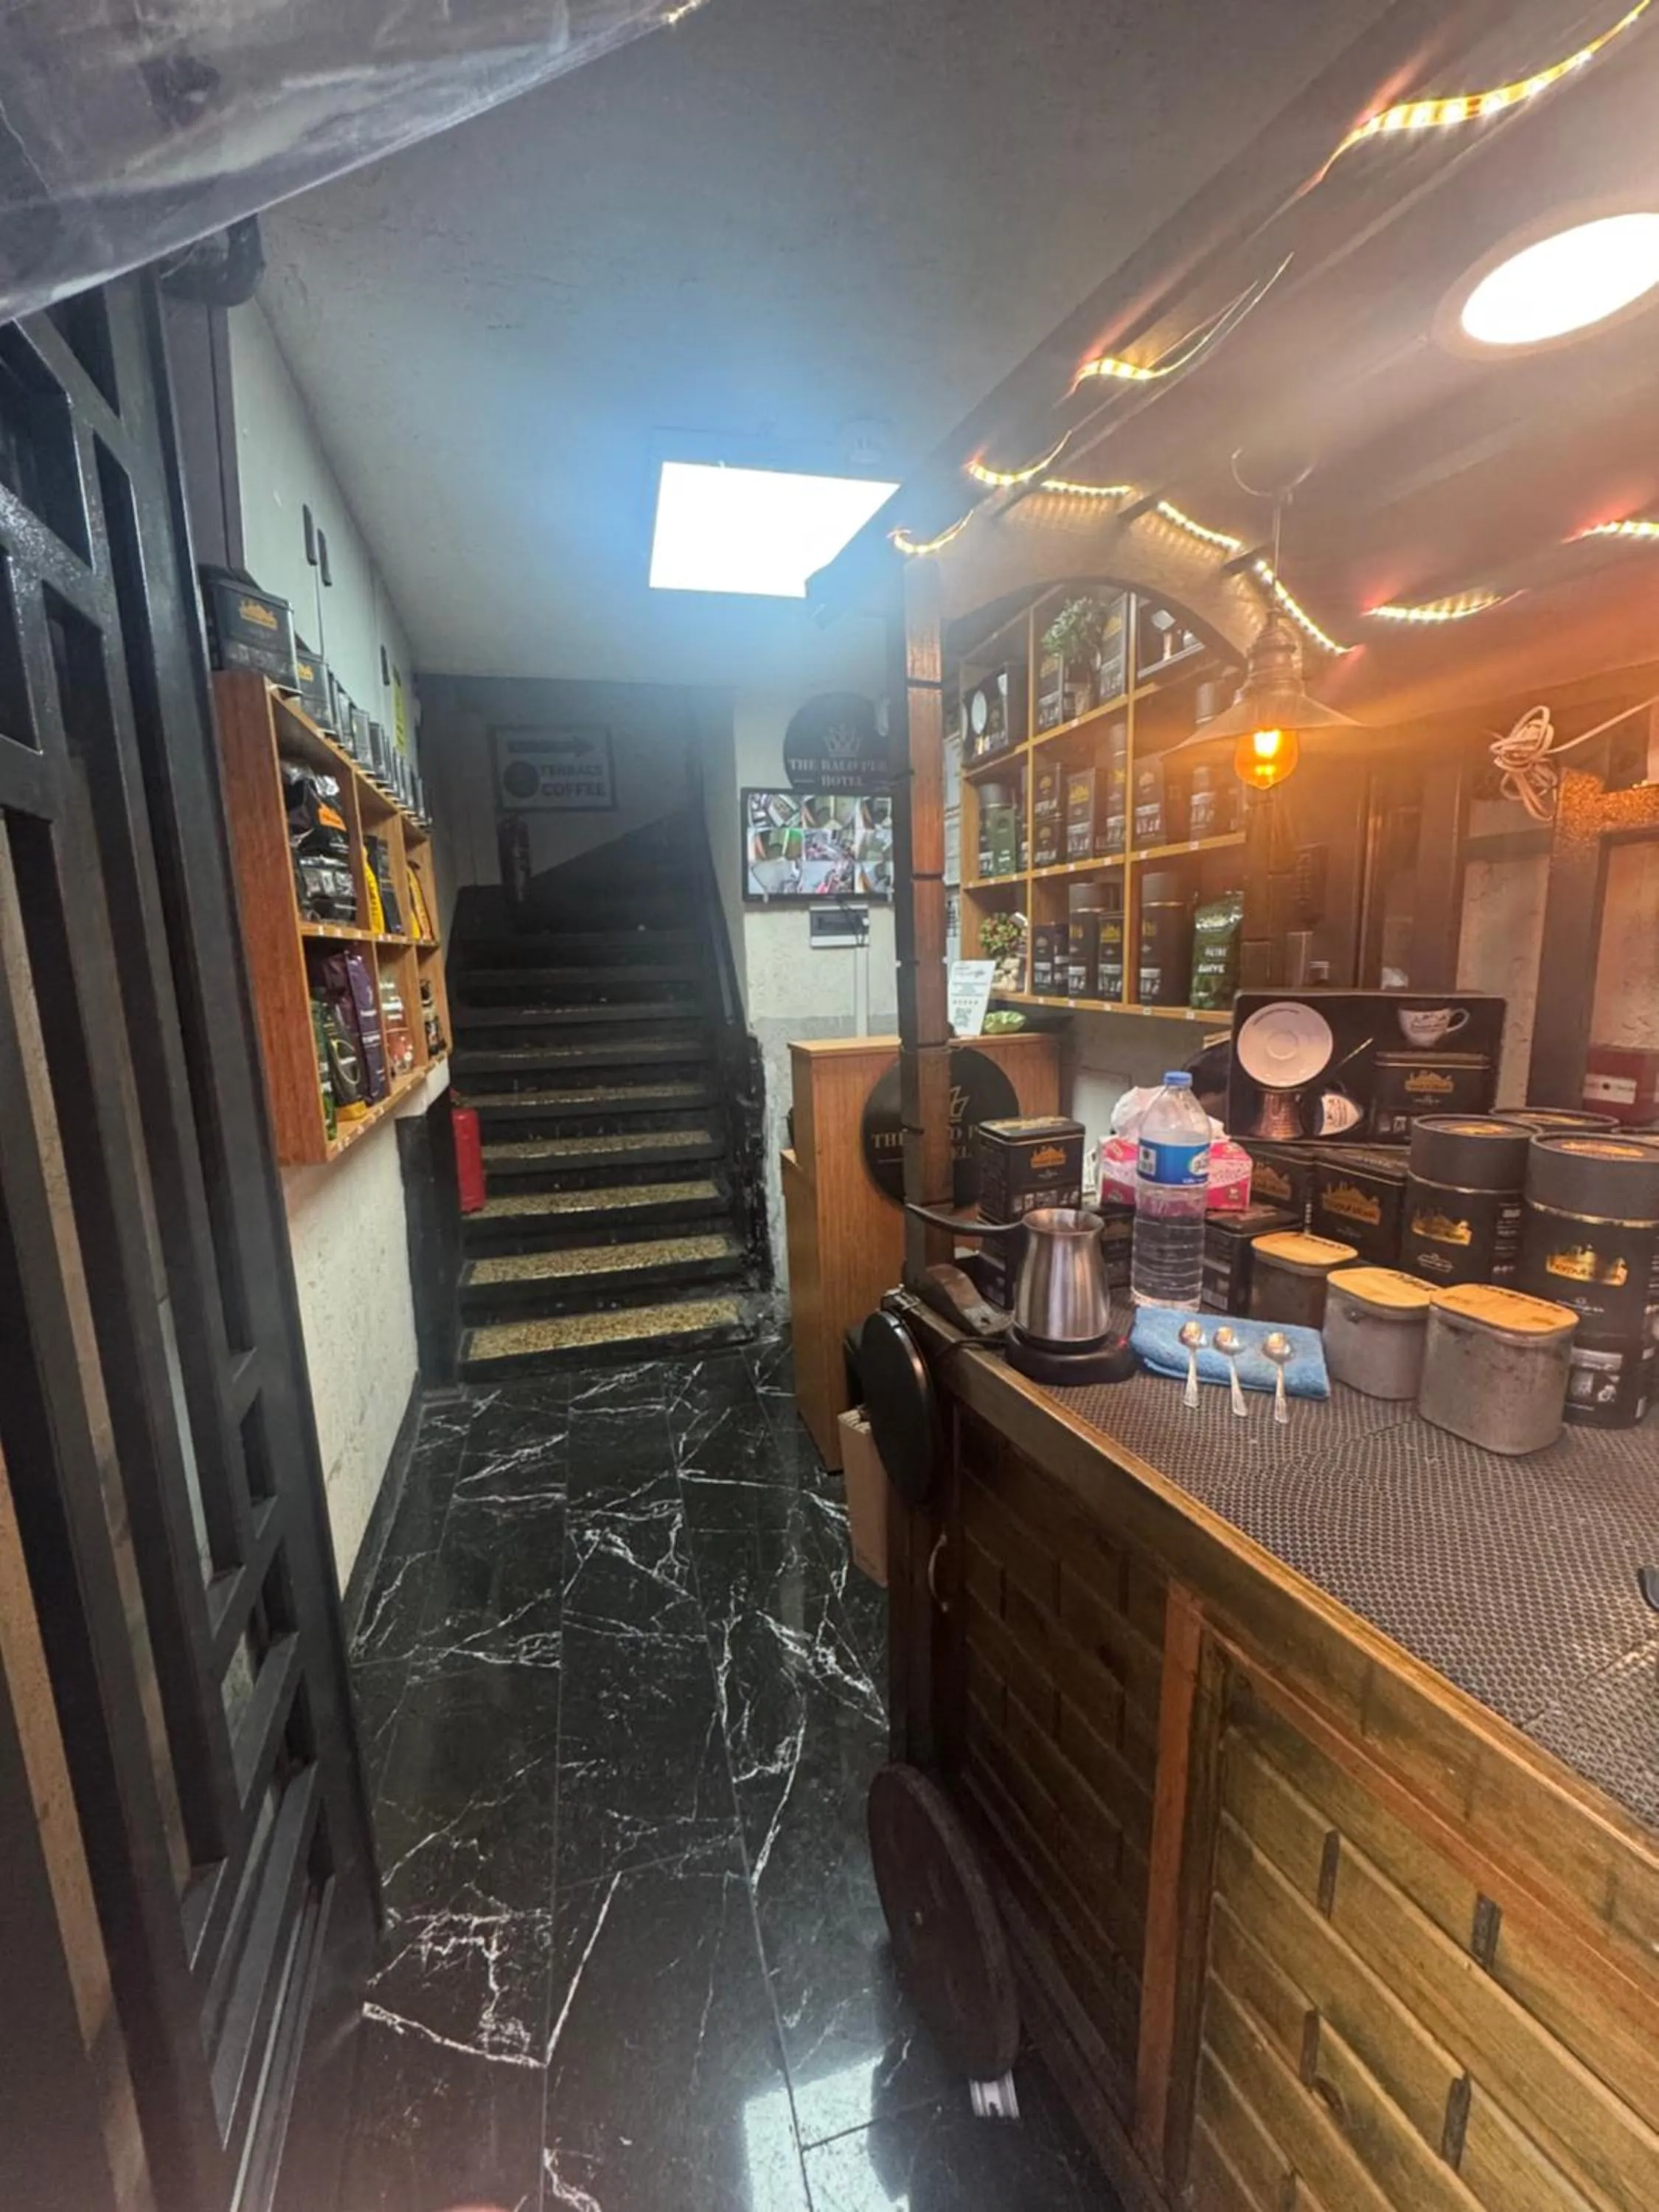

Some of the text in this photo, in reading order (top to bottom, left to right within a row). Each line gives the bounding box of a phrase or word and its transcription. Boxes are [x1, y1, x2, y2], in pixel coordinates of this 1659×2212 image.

[788, 758, 816, 771] THE
[821, 774, 863, 787] HOTEL
[541, 782, 606, 798] COFFEE
